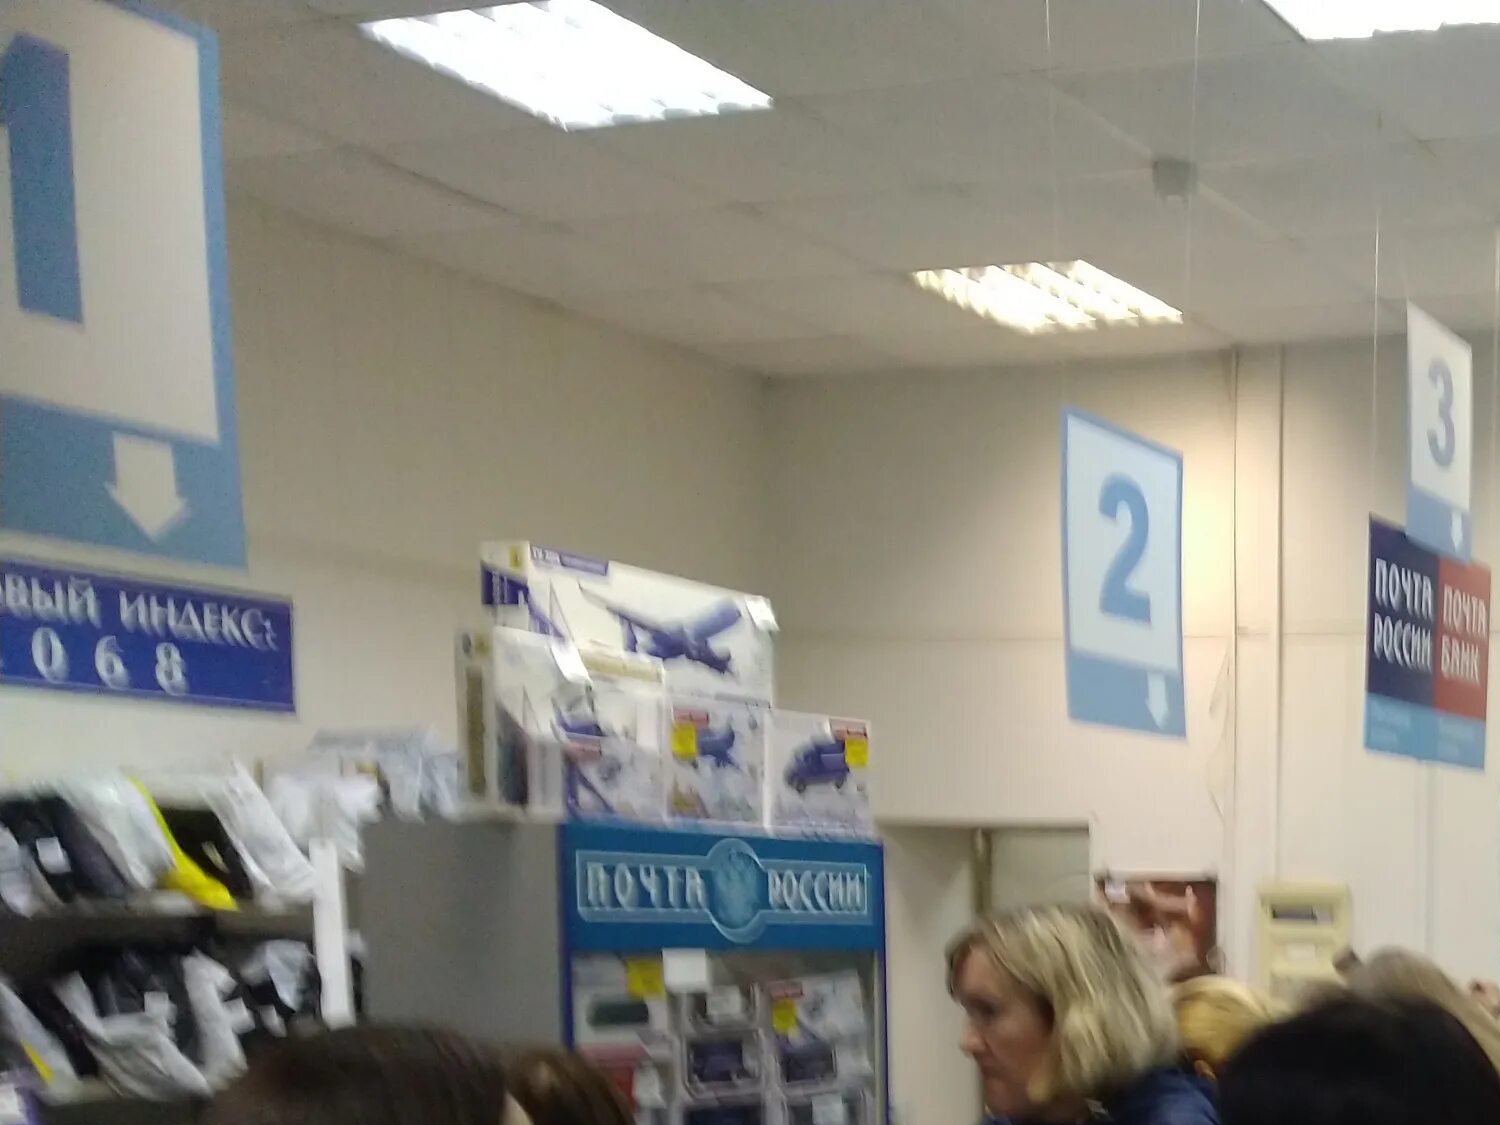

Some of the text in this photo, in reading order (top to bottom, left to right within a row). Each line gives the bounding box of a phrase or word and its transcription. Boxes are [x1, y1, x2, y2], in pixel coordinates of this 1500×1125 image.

[0, 32, 84, 324] 1
[1426, 358, 1456, 466] 3
[1099, 473, 1151, 623] 2
[0, 573, 101, 629] ВЫЙ
[1375, 558, 1434, 622] ПОЧТА
[1443, 584, 1488, 642] ПОЧТА
[1373, 613, 1433, 673] РОССИИ
[1441, 636, 1480, 684] БАНК
[586, 861, 864, 914] ПОЧТА РОССИИ
